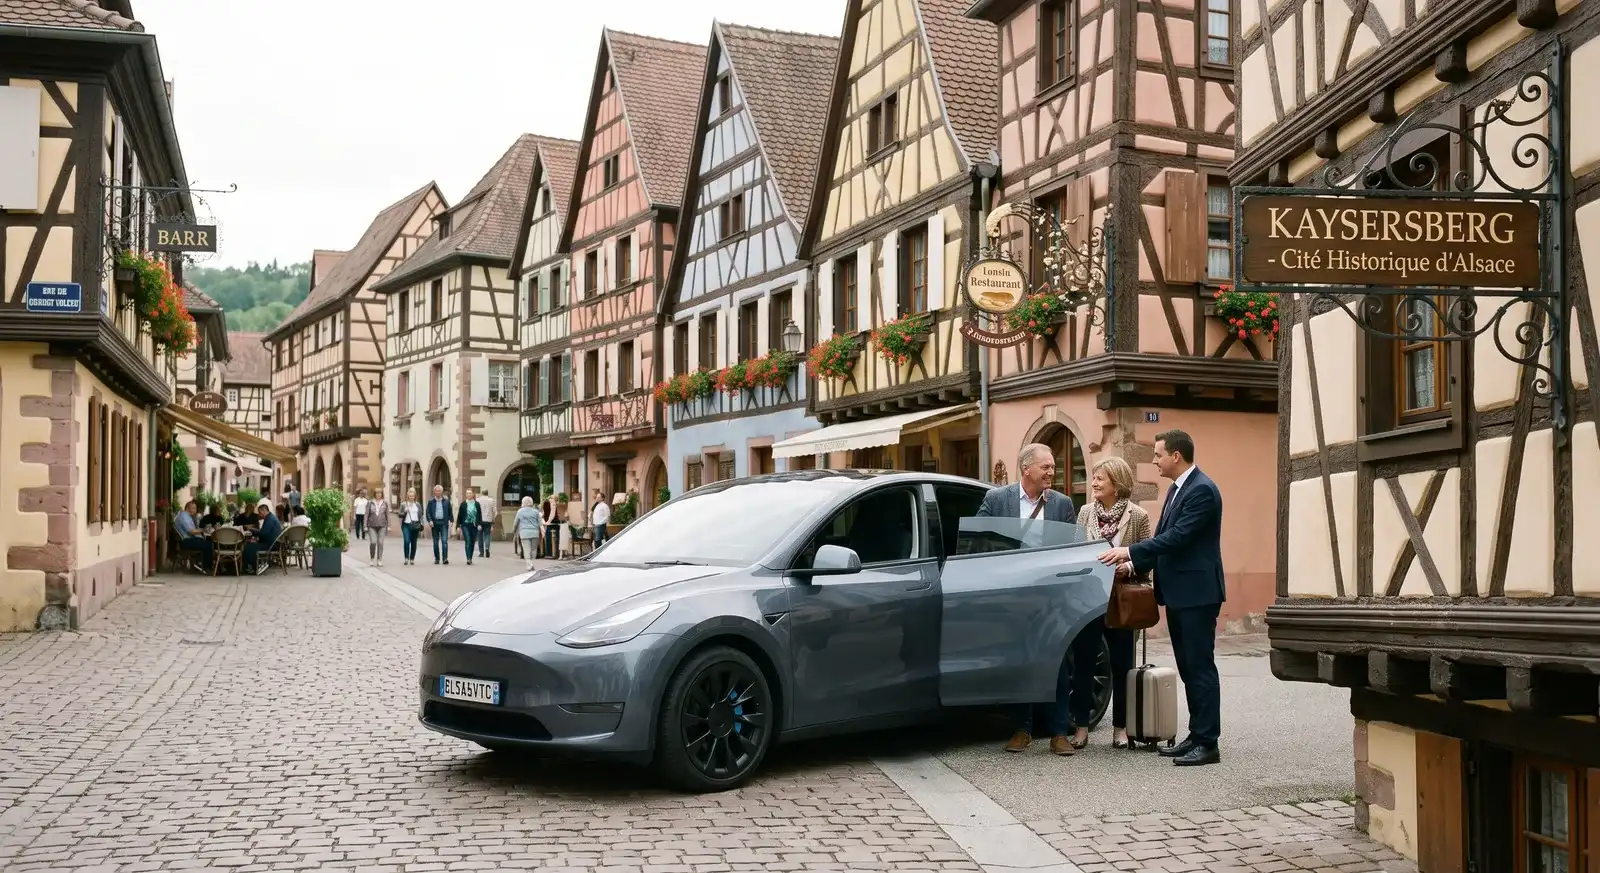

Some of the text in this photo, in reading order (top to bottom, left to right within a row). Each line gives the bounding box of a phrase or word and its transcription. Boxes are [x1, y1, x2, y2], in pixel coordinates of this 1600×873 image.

[1268, 207, 1515, 244] KAYSERSBERG
[157, 229, 209, 247] BARR
[1280, 248, 1321, 270] Cité
[1327, 249, 1430, 278] Historique
[1435, 251, 1515, 274] d'Alsace
[970, 276, 1021, 289] Restaurant
[1149, 412, 1157, 421] 10
